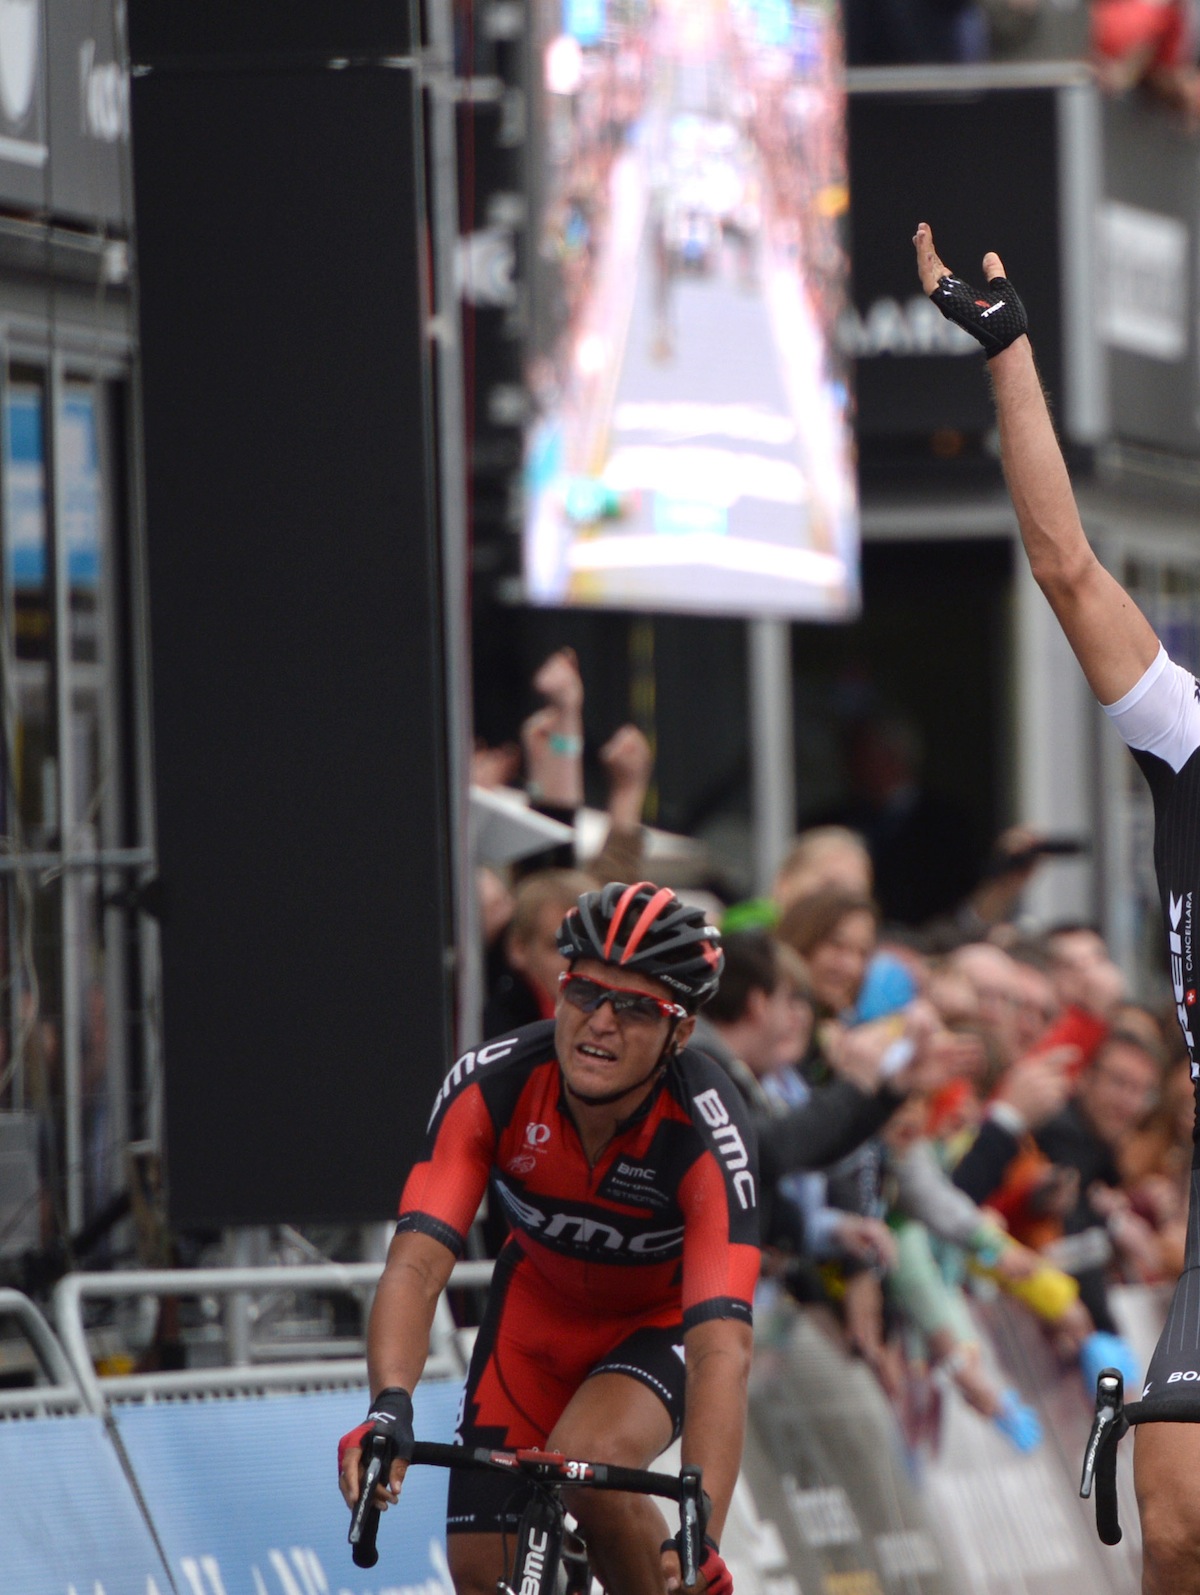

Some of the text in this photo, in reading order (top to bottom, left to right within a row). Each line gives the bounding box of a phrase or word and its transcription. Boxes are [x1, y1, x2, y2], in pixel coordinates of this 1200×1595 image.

[1184, 891, 1193, 971] CANCELLARA
[616, 1161, 657, 1181] BMC
[692, 1088, 757, 1210] BMC
[494, 1178, 685, 1254] BMC
[566, 1460, 590, 1481] 3T
[518, 1527, 548, 1595] BMC
